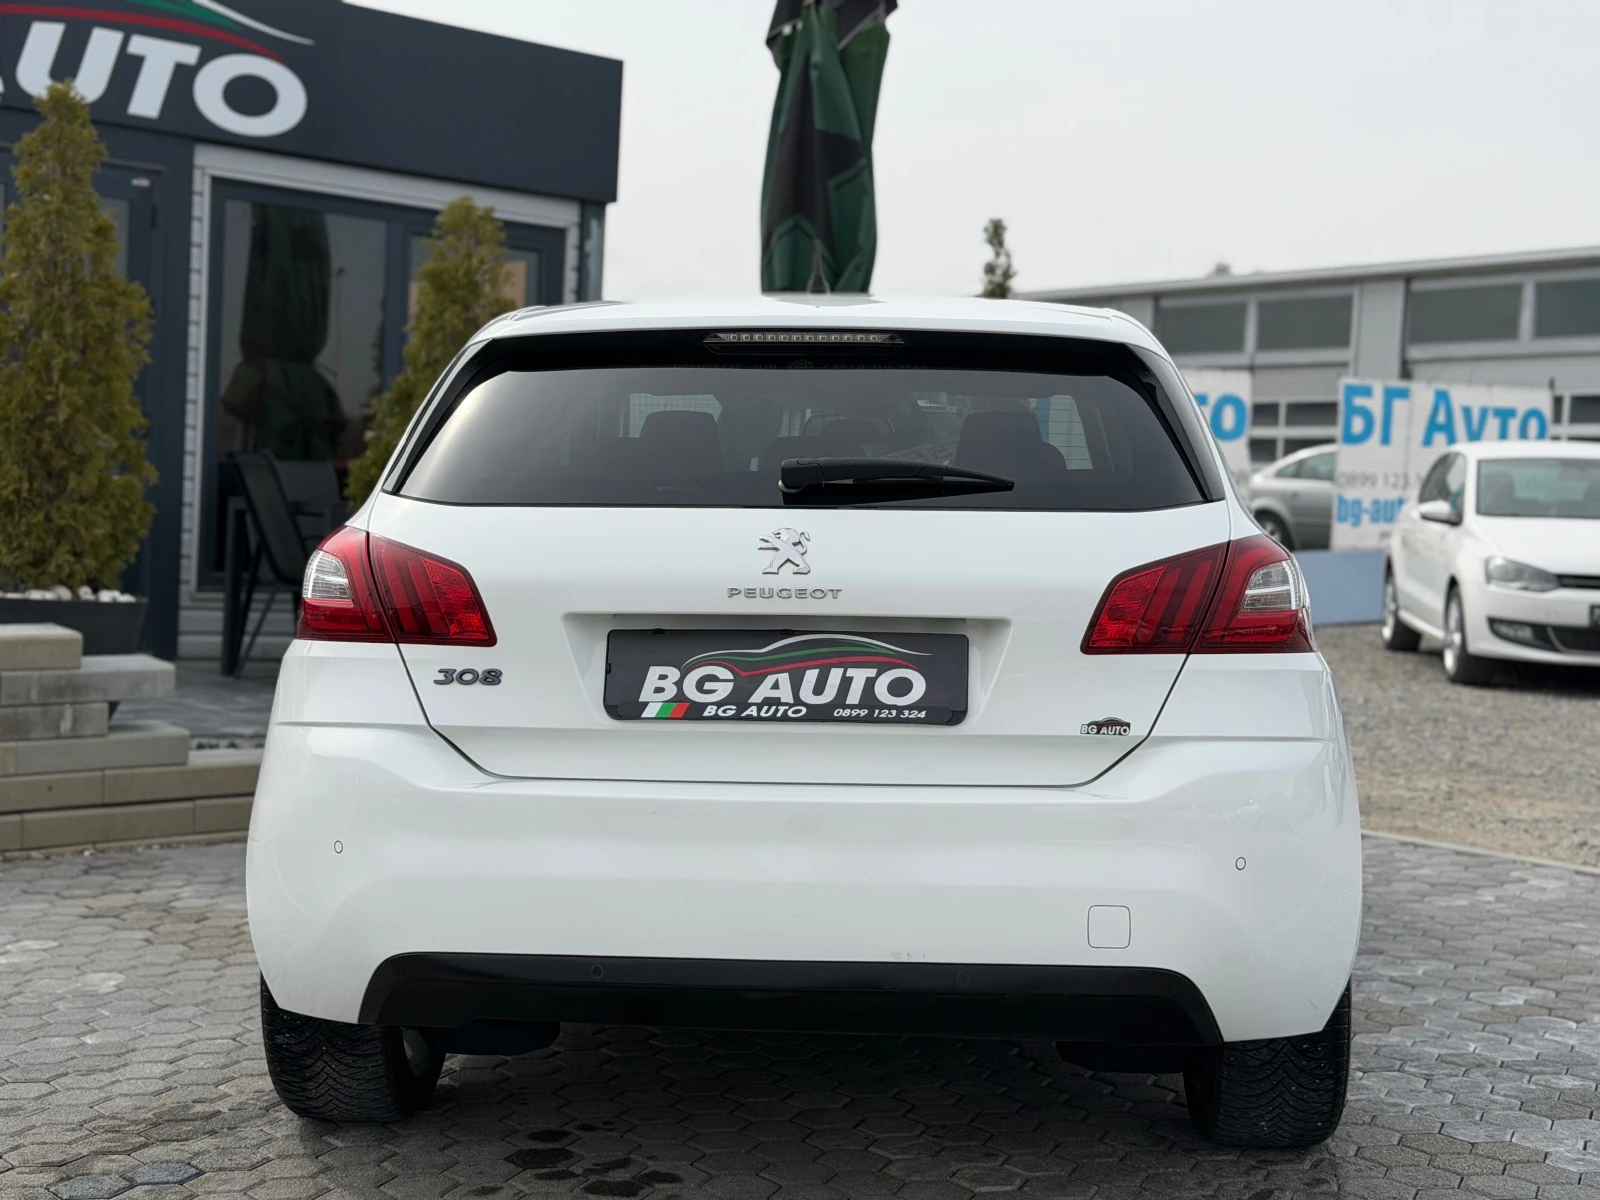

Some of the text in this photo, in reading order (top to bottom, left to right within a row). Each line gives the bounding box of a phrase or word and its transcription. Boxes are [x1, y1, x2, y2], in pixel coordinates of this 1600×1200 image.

[0, 21, 308, 137] UTO
[1342, 383, 1410, 446] БГ
[727, 586, 843, 599] PEUGEOT
[433, 668, 503, 686] 308
[639, 665, 927, 706] BG AUTO
[702, 705, 807, 718] BG AUTO
[833, 708, 927, 719] 0899 123 324
[1081, 725, 1129, 735] BG AUTO
